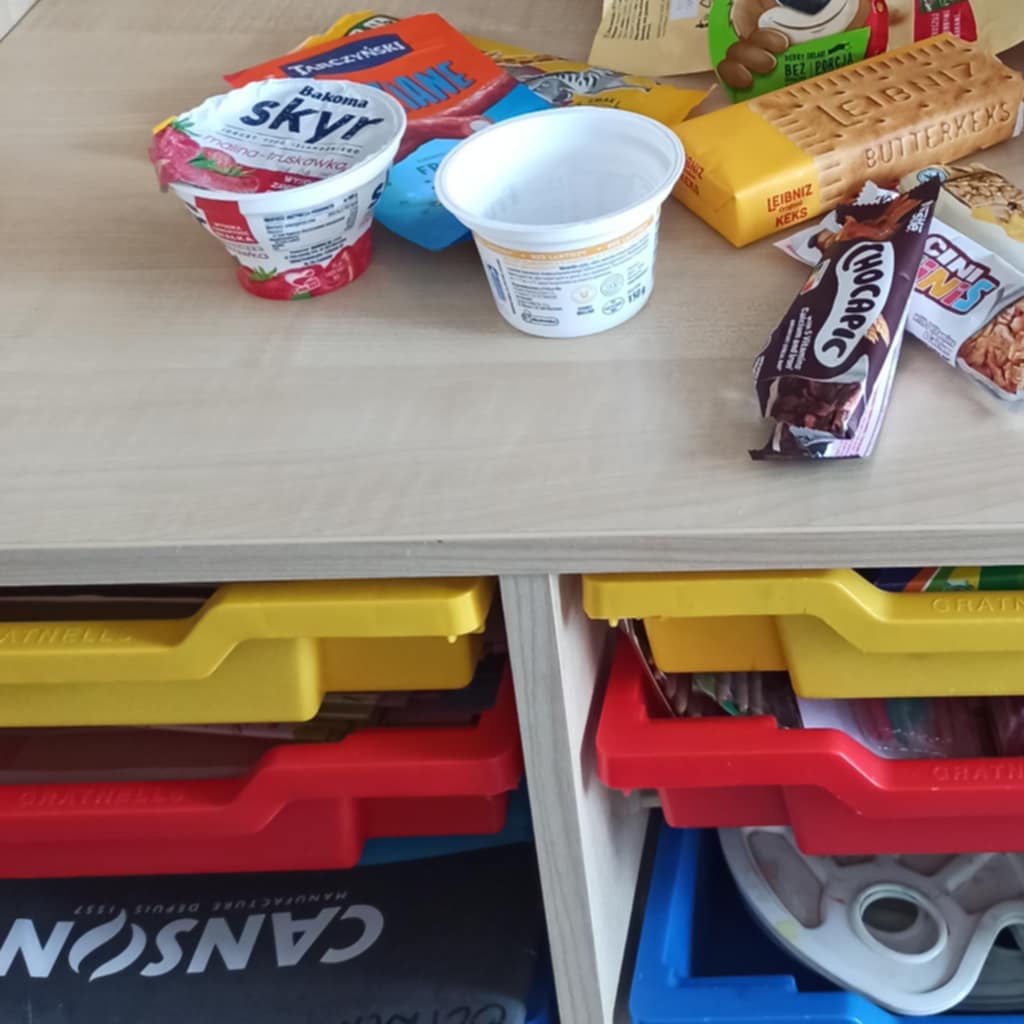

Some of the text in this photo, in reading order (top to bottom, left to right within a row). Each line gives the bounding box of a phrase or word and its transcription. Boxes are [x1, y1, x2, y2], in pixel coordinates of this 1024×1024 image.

[299, 85, 369, 109] Bakoma
[816, 61, 973, 127] LEIBNIZ
[240, 97, 385, 144] skyr
[864, 102, 1011, 169] BUTTERKEKS
[767, 183, 813, 213] LEIBNIZ
[775, 206, 808, 228] KEKS
[924, 236, 985, 284] CINI
[821, 243, 885, 360] CHOCAPIC
[0, 904, 384, 983] CANSON
